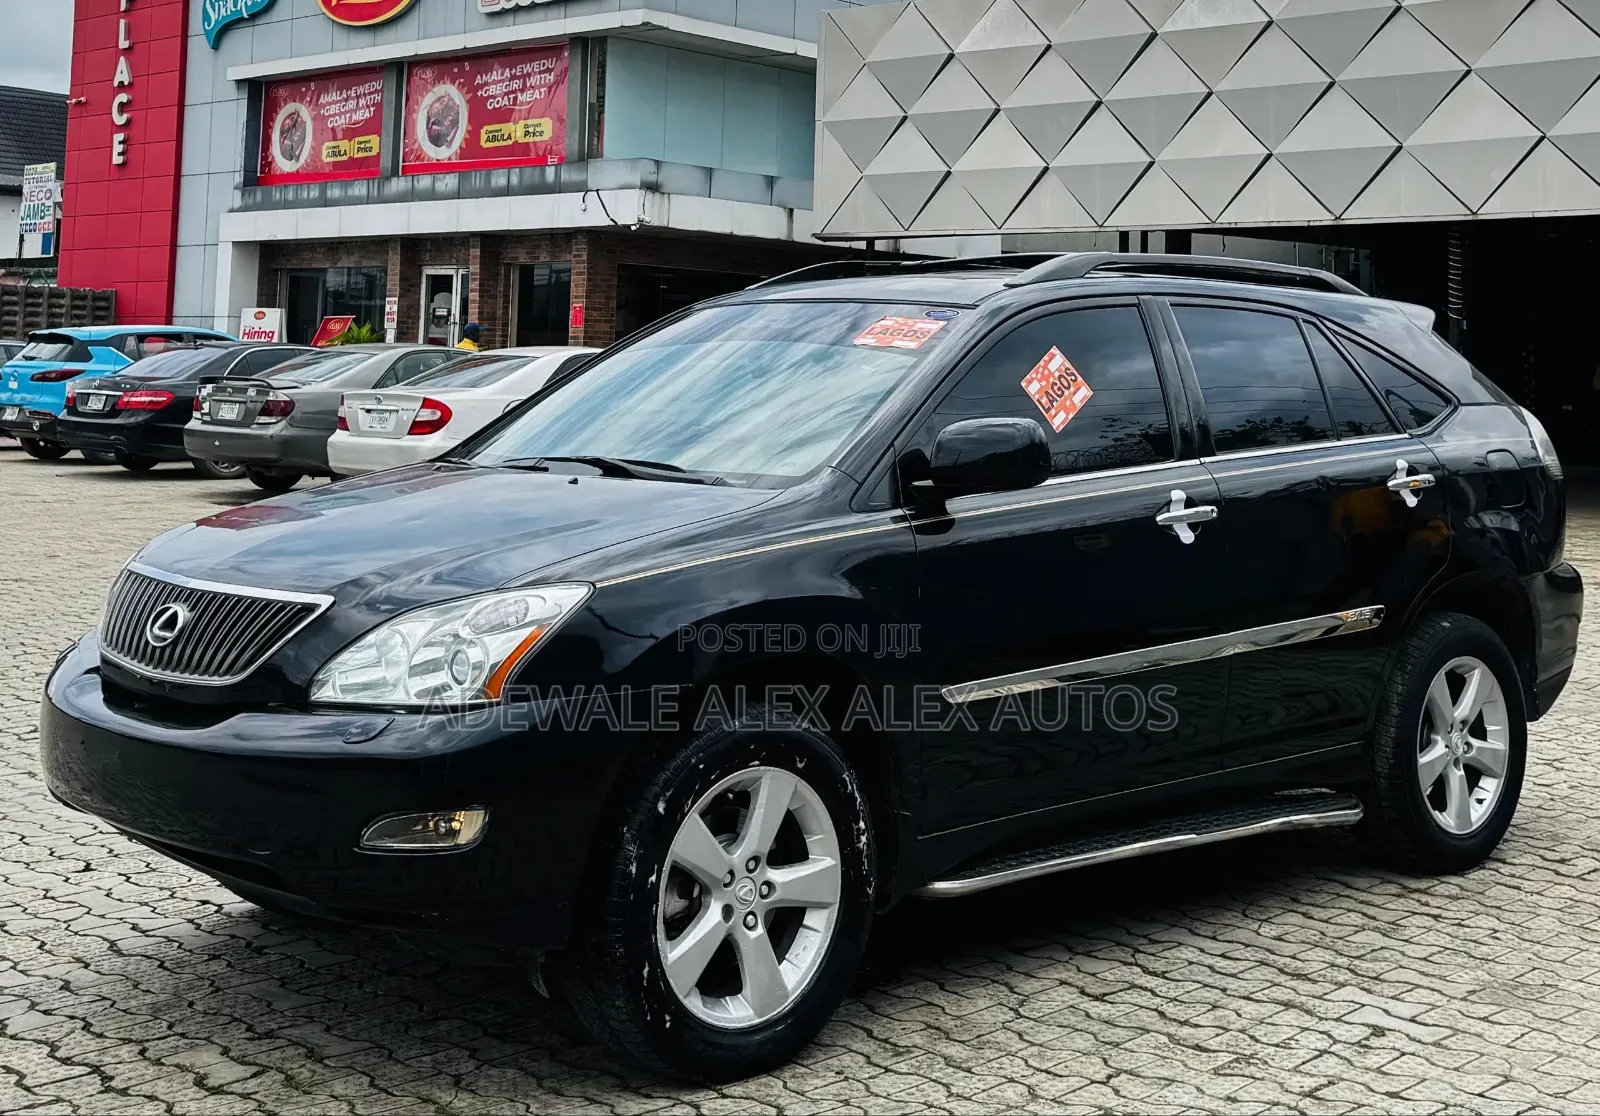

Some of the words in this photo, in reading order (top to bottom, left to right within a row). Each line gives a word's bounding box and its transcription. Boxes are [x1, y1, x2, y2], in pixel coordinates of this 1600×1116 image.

[474, 57, 556, 85] AMALA+EWEDU
[318, 79, 383, 104] AMALA+EWEDU
[477, 81, 523, 97] +GBEGIRI
[526, 71, 555, 88] WITH
[320, 101, 357, 117] +GBEGIRI
[358, 93, 382, 108] WITH
[486, 96, 514, 110] GOAT
[517, 87, 547, 104] MEAT
[327, 115, 350, 128] GOAT
[351, 107, 376, 123] MEAT
[485, 133, 512, 144] ABULA
[523, 128, 544, 139] Price
[325, 149, 348, 159] ABULA
[356, 145, 374, 155] Price
[24, 175, 53, 185] TUTORIAL
[21, 202, 46, 221] JAMB
[241, 326, 275, 343] Hiring
[865, 325, 932, 340] LAGOS
[1035, 366, 1078, 414] LAGOS
